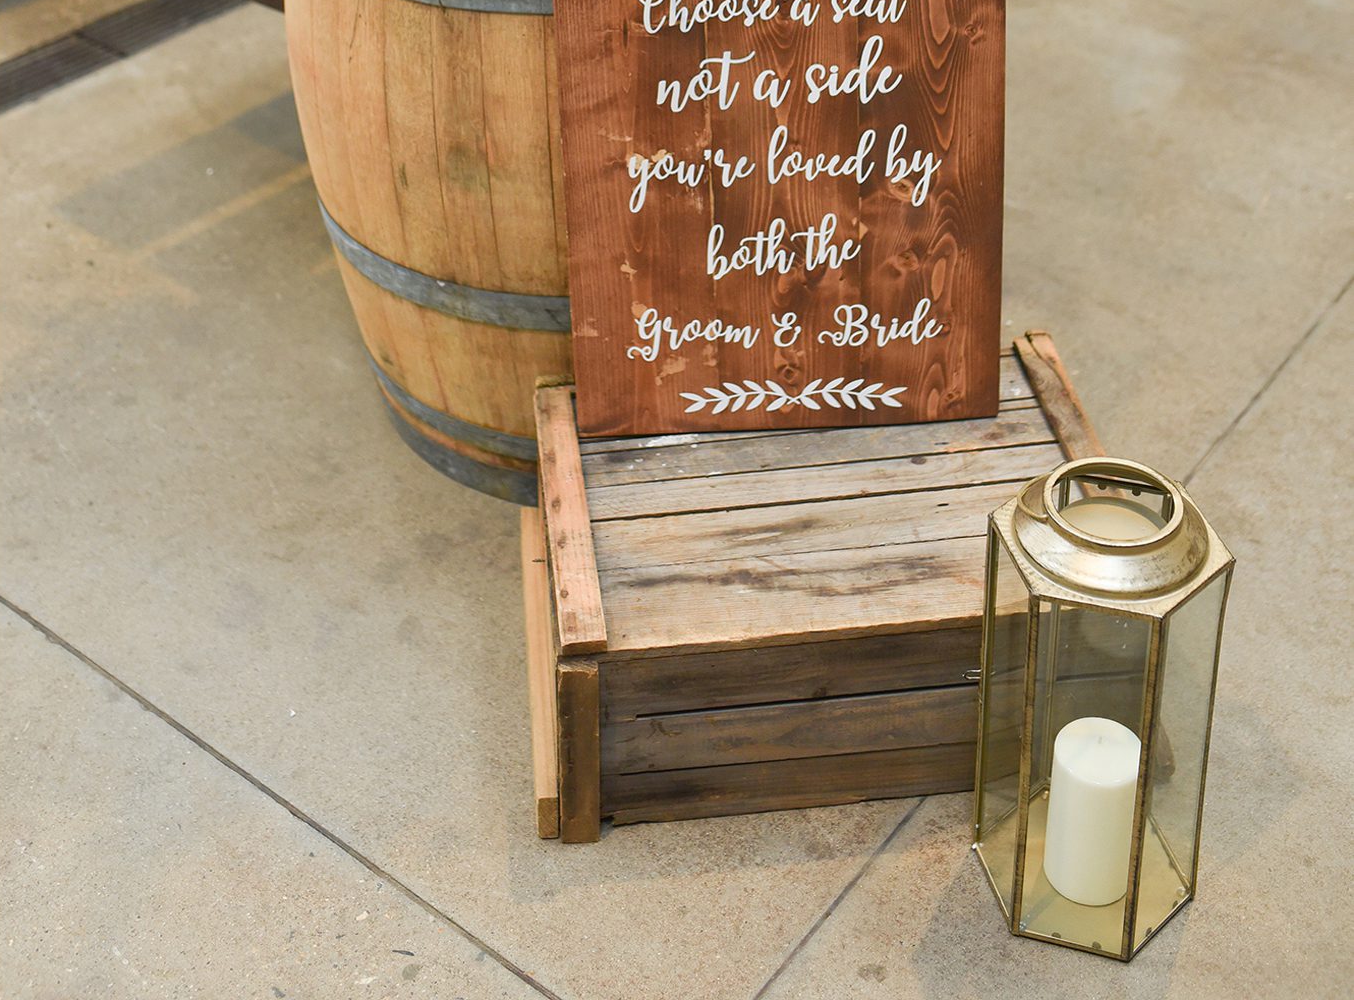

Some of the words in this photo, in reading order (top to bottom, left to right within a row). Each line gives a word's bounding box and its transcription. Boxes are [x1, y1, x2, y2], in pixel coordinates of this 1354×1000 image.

[656, 49, 756, 113] not
[753, 69, 791, 108] a
[805, 34, 903, 105] side
[627, 147, 755, 214] you're
[766, 124, 876, 186] loved
[884, 123, 943, 208] by
[706, 217, 798, 281] both
[790, 212, 862, 272] the
[626, 307, 761, 362] Groom
[770, 311, 802, 349] &
[817, 297, 944, 348] Bride
